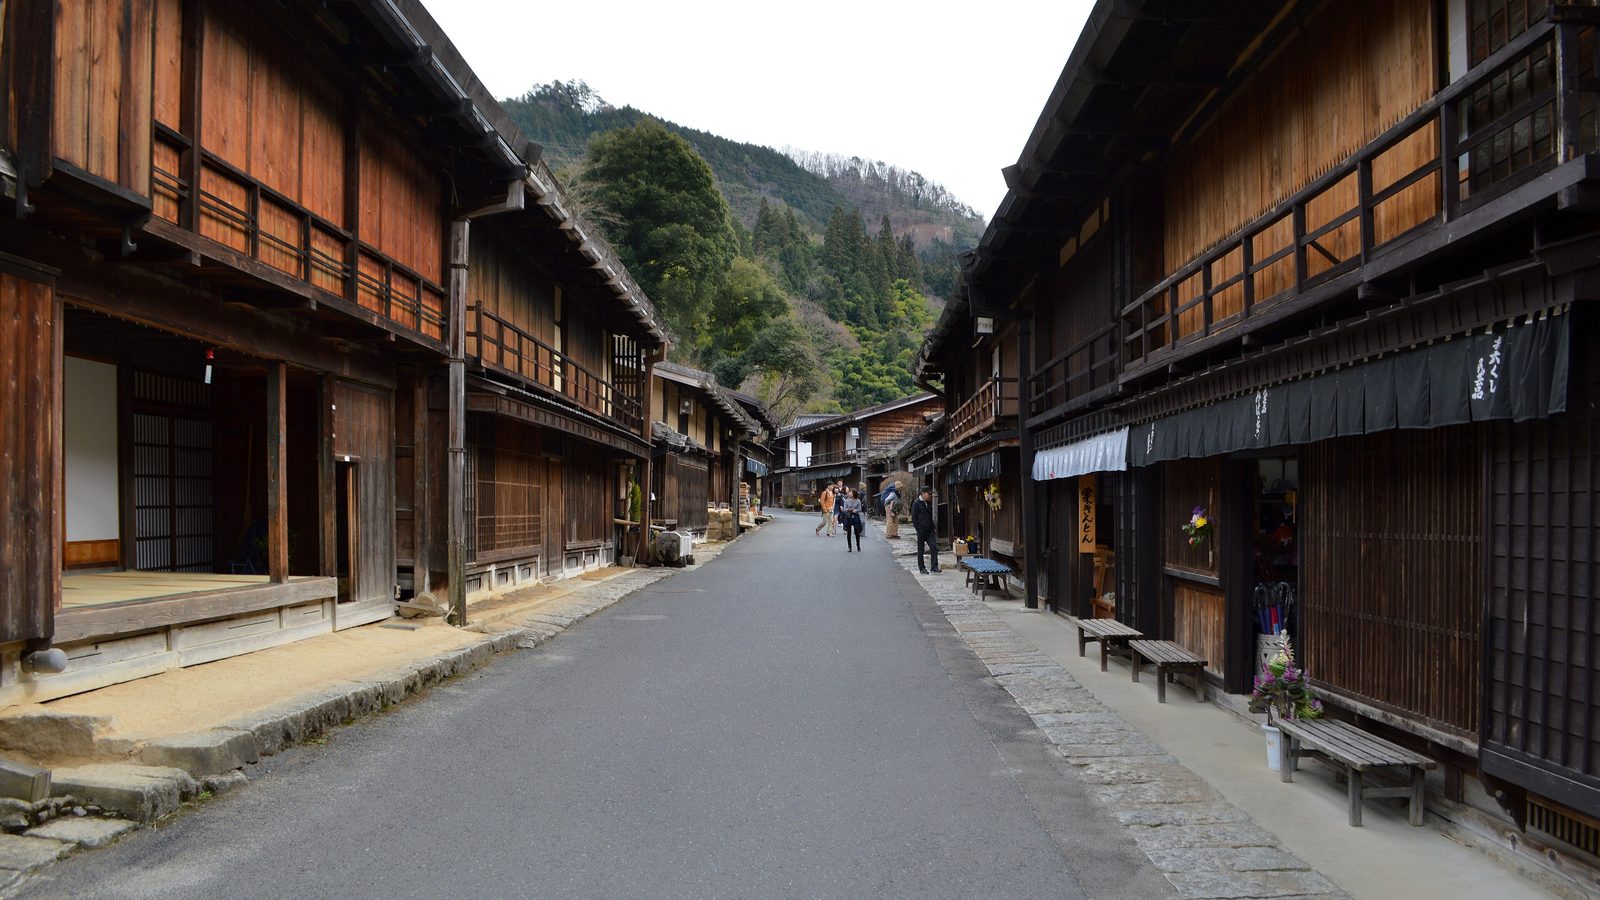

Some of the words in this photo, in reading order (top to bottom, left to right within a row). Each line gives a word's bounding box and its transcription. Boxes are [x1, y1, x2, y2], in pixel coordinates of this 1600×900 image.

[1081, 486, 1094, 544] 栗きんとん
